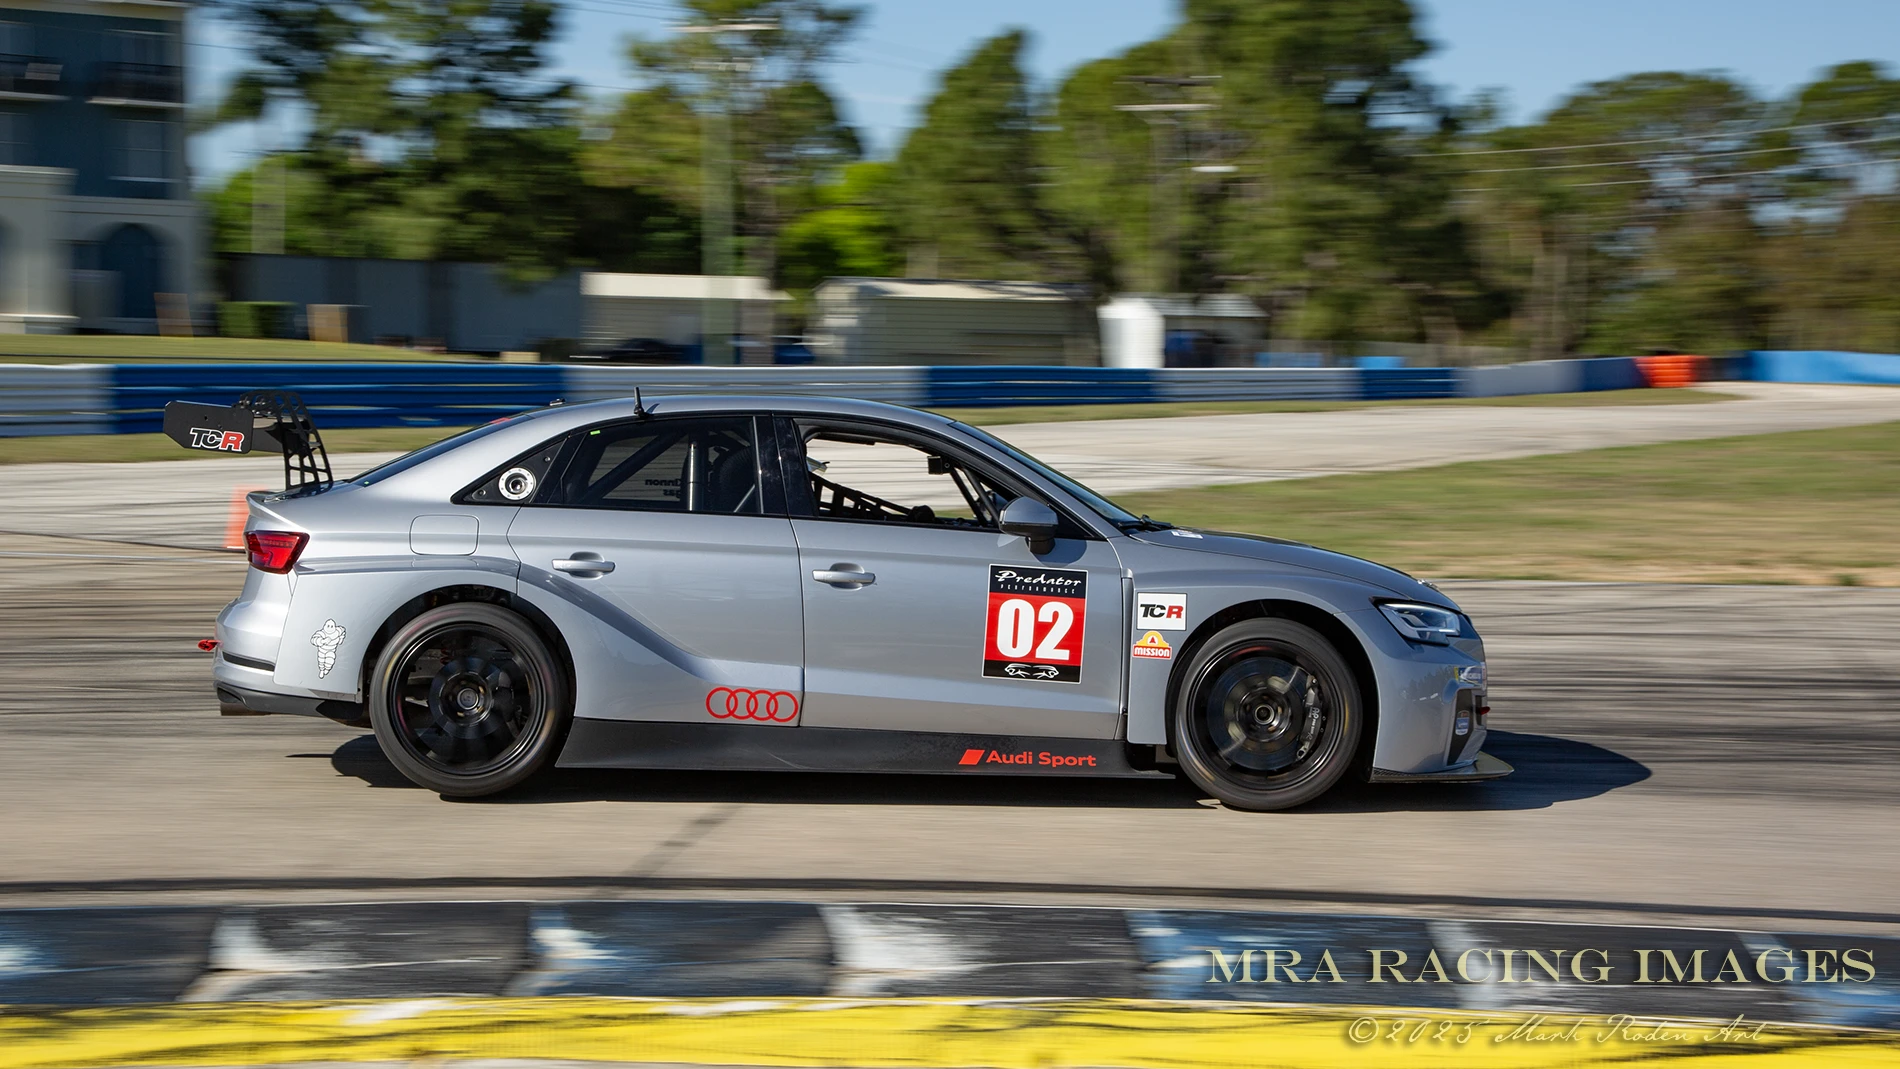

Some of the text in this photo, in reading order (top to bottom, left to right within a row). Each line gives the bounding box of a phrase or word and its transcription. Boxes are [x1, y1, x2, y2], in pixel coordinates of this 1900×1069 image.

[190, 427, 245, 452] TCR
[995, 570, 1082, 587] Predator
[1140, 604, 1184, 619] TCR
[996, 598, 1075, 661] 02
[986, 750, 1097, 768] Audi Sport
